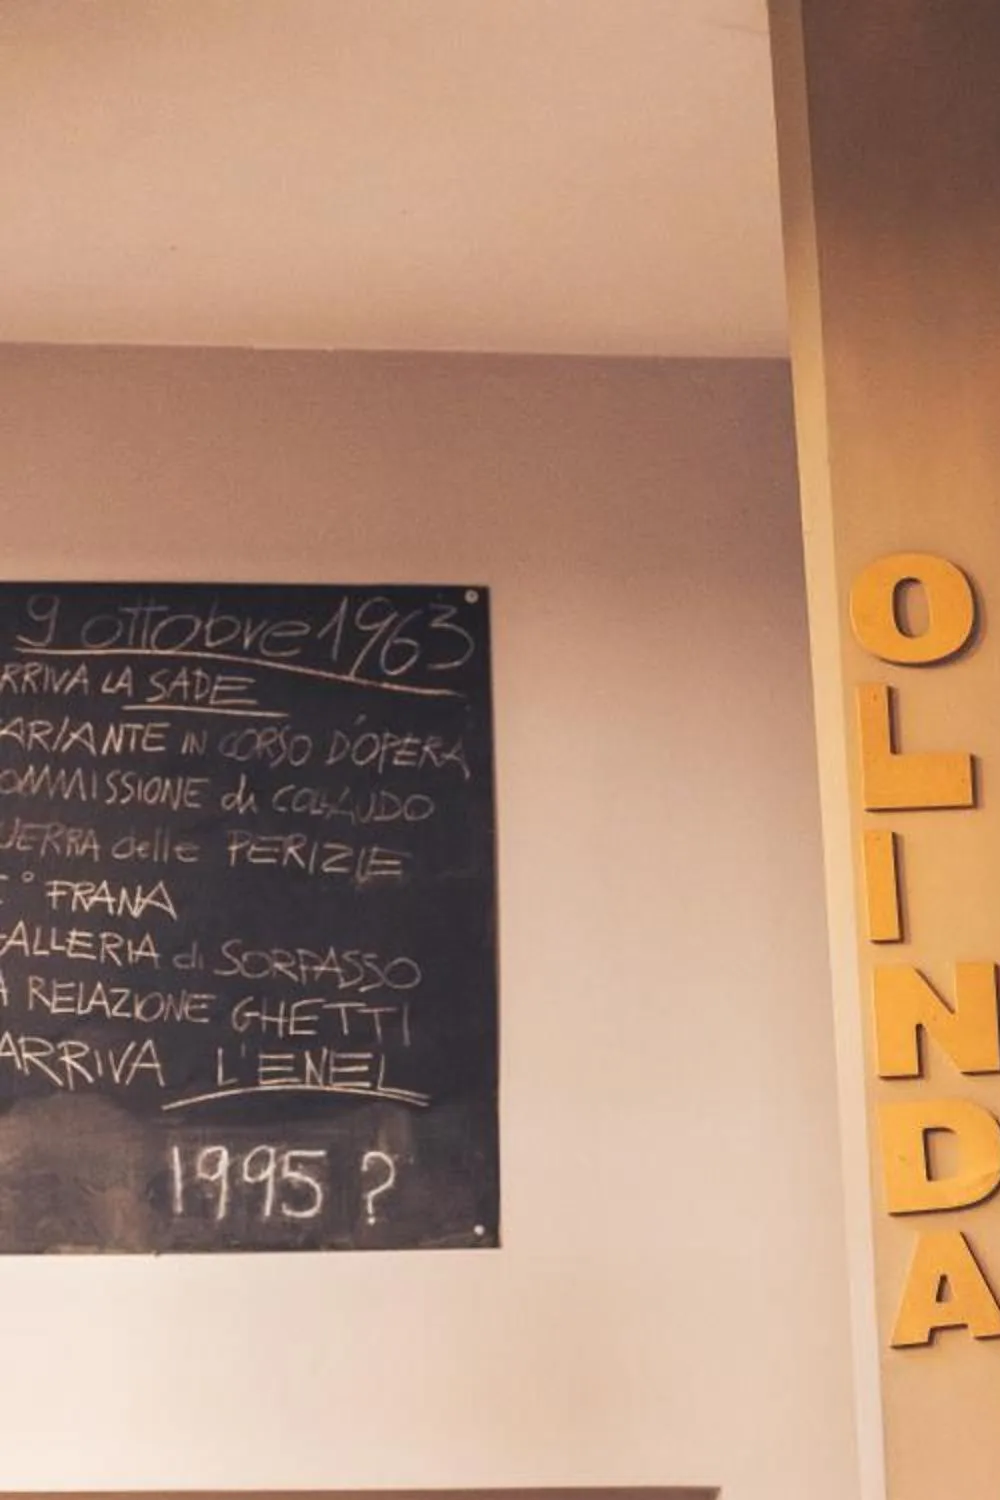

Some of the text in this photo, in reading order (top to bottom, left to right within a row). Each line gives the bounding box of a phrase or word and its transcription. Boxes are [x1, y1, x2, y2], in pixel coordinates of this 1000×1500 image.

[16, 595, 61, 648] 9
[318, 596, 475, 678] 1963
[102, 668, 133, 698] LA
[145, 668, 259, 704] SADE
[181, 730, 207, 756] IN
[218, 725, 313, 768] CORSO
[227, 829, 413, 882] PERIZIE
[45, 880, 177, 918] FRANA
[0, 920, 160, 967] ALLERIA
[214, 939, 422, 993] SORPASSO
[28, 974, 217, 1023] RELAZIONE
[231, 998, 412, 1047] GHETTI
[0, 1031, 165, 1092] ARRIVA
[171, 1145, 328, 1221] 1995
